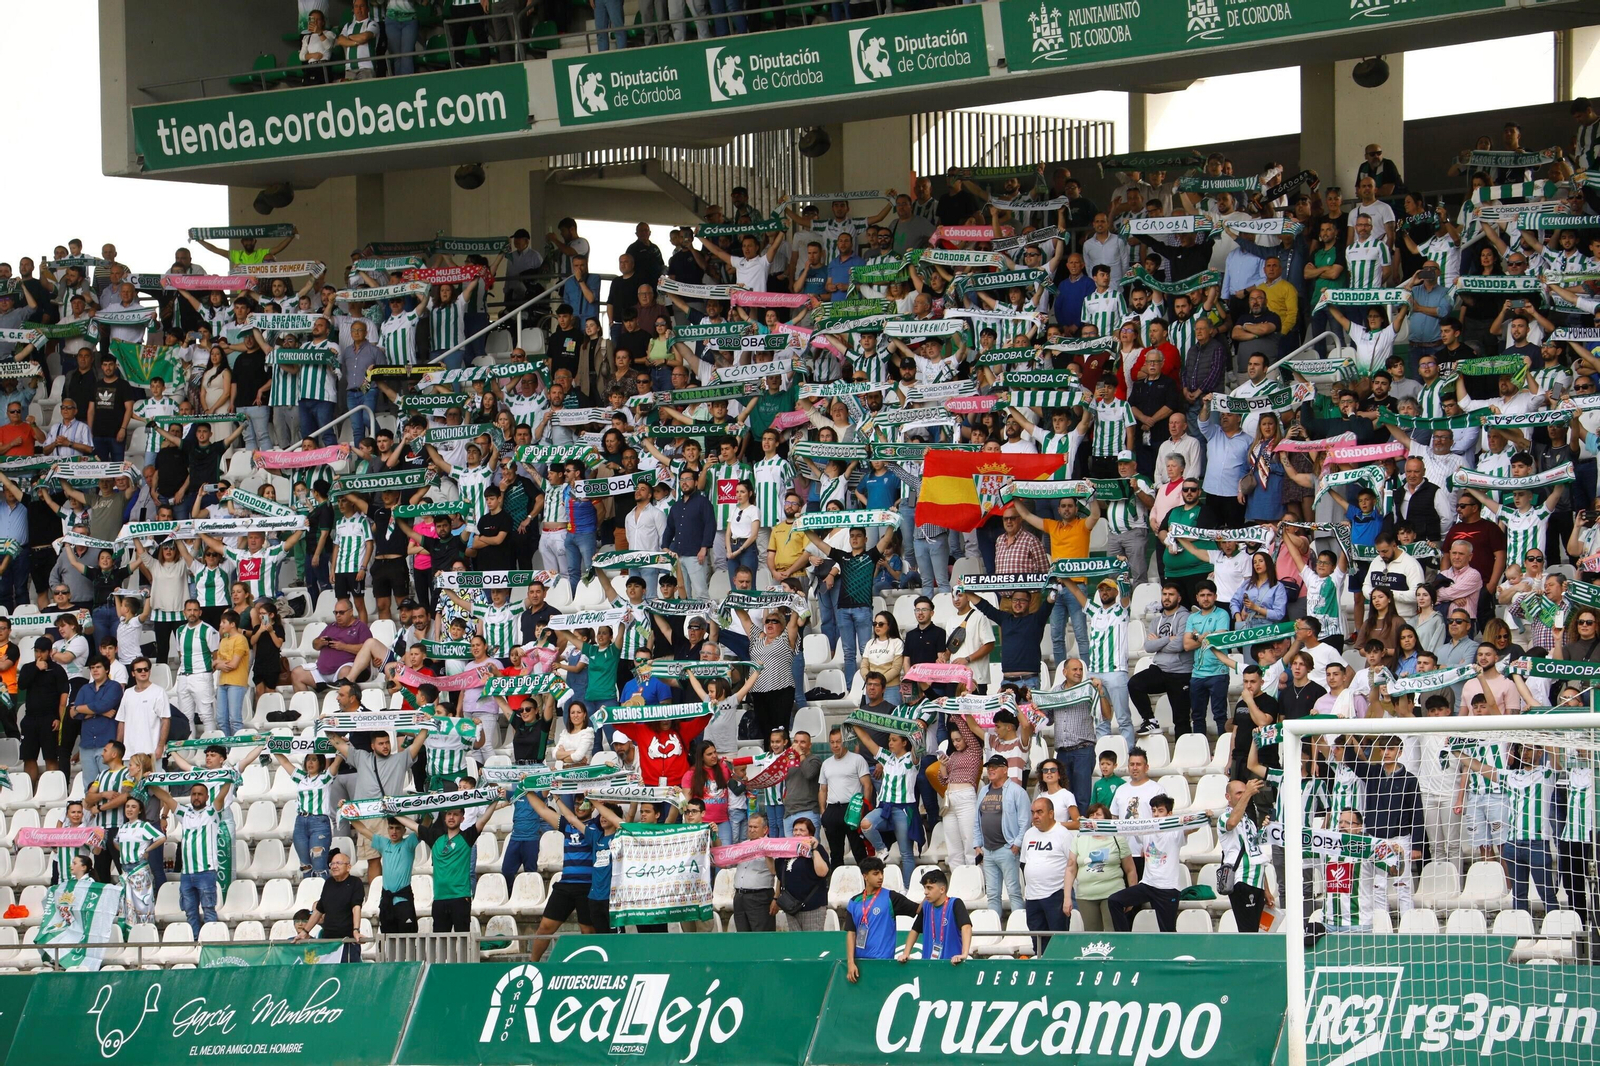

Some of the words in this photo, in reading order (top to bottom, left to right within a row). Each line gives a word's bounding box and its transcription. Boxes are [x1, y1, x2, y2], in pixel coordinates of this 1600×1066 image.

[1068, 1, 1141, 27] AYUNTAMIENTO
[1227, 8, 1240, 27] DE
[1242, 2, 1292, 25] CORDOBA
[895, 29, 968, 55] Diputación
[1070, 31, 1082, 49] DE
[1084, 23, 1132, 47] CORDOBA
[749, 49, 820, 72] Diputación
[898, 56, 914, 73] de
[916, 50, 971, 71] Córdoba
[610, 66, 678, 89] Diputación
[753, 74, 769, 91] de
[771, 69, 824, 88] Córdoba
[614, 91, 629, 107] de
[632, 86, 681, 106] Córdoba
[157, 87, 507, 156] tienda.cordobacf.com
[944, 227, 981, 237] CÓRDOBA
[1136, 220, 1188, 230] CÓRDOBA
[445, 240, 491, 251] CÓRDOBA
[933, 252, 970, 263] CÓRDOBA
[974, 253, 988, 262] C.F.
[248, 265, 268, 273] SOMOS
[270, 265, 278, 273] DE
[279, 263, 305, 273] PRIMERA
[436, 267, 461, 276] MUJER
[426, 273, 471, 283] CORDOBESA
[978, 272, 1027, 286] CÓRDOBA
[1463, 278, 1517, 289] CÓRDOBA
[1523, 279, 1541, 289] C.F.
[352, 288, 390, 298] CÓRDOBA
[393, 285, 407, 294] C.F.
[1332, 290, 1379, 300] CÓRDOBA
[1385, 290, 1402, 300] C.F.
[256, 321, 289, 329] NUESTRO
[678, 323, 729, 337] CÓRDOBA
[769, 336, 785, 347] CF
[980, 350, 1022, 362] CÓRDOBA
[725, 361, 784, 377] CÓRDOBA
[1007, 372, 1053, 383] CÓRDOBA
[1056, 374, 1068, 382] CF
[406, 394, 453, 405] CÓRDOBA
[1274, 392, 1289, 406] CF
[464, 425, 479, 437] CF
[1334, 445, 1383, 459] CÓRDOBA
[346, 475, 403, 489] CÓRDOBA
[406, 474, 421, 484] CF
[803, 514, 851, 525] CÓRDOBA
[856, 513, 874, 523] C.F.
[1058, 558, 1110, 572] CÓRDOBA
[512, 573, 529, 584] CF
[964, 575, 976, 584] DE
[979, 574, 1015, 583] PADRES
[1017, 574, 1024, 582] A
[1026, 574, 1048, 582] HIJO
[1222, 624, 1280, 643] CÓRDOBA
[492, 676, 549, 688] CORDOBA
[612, 705, 642, 720] SUEÑOS
[644, 703, 703, 718] BLANQUIVERDES
[600, 787, 655, 796] CORDOBA
[401, 789, 484, 809] CÓRDOBA
[1027, 841, 1053, 850] FILA
[626, 859, 700, 878] CÓRDOBA
[547, 975, 628, 991] AUTOESCUELAS
[976, 971, 1054, 986] DESDE
[1076, 971, 1141, 987] 1904
[172, 997, 236, 1038] García
[251, 977, 343, 1027] Mimbrero
[874, 975, 1222, 1066] Cruzcampo
[1306, 994, 1384, 1045] RG3
[189, 1046, 199, 1056] EL
[200, 1045, 226, 1056] MEJOR
[227, 1044, 252, 1055] AMIGO
[253, 1044, 268, 1054] DEL
[269, 1043, 304, 1054] HOMBRE
[610, 1044, 645, 1054] PRÁCTICAS
